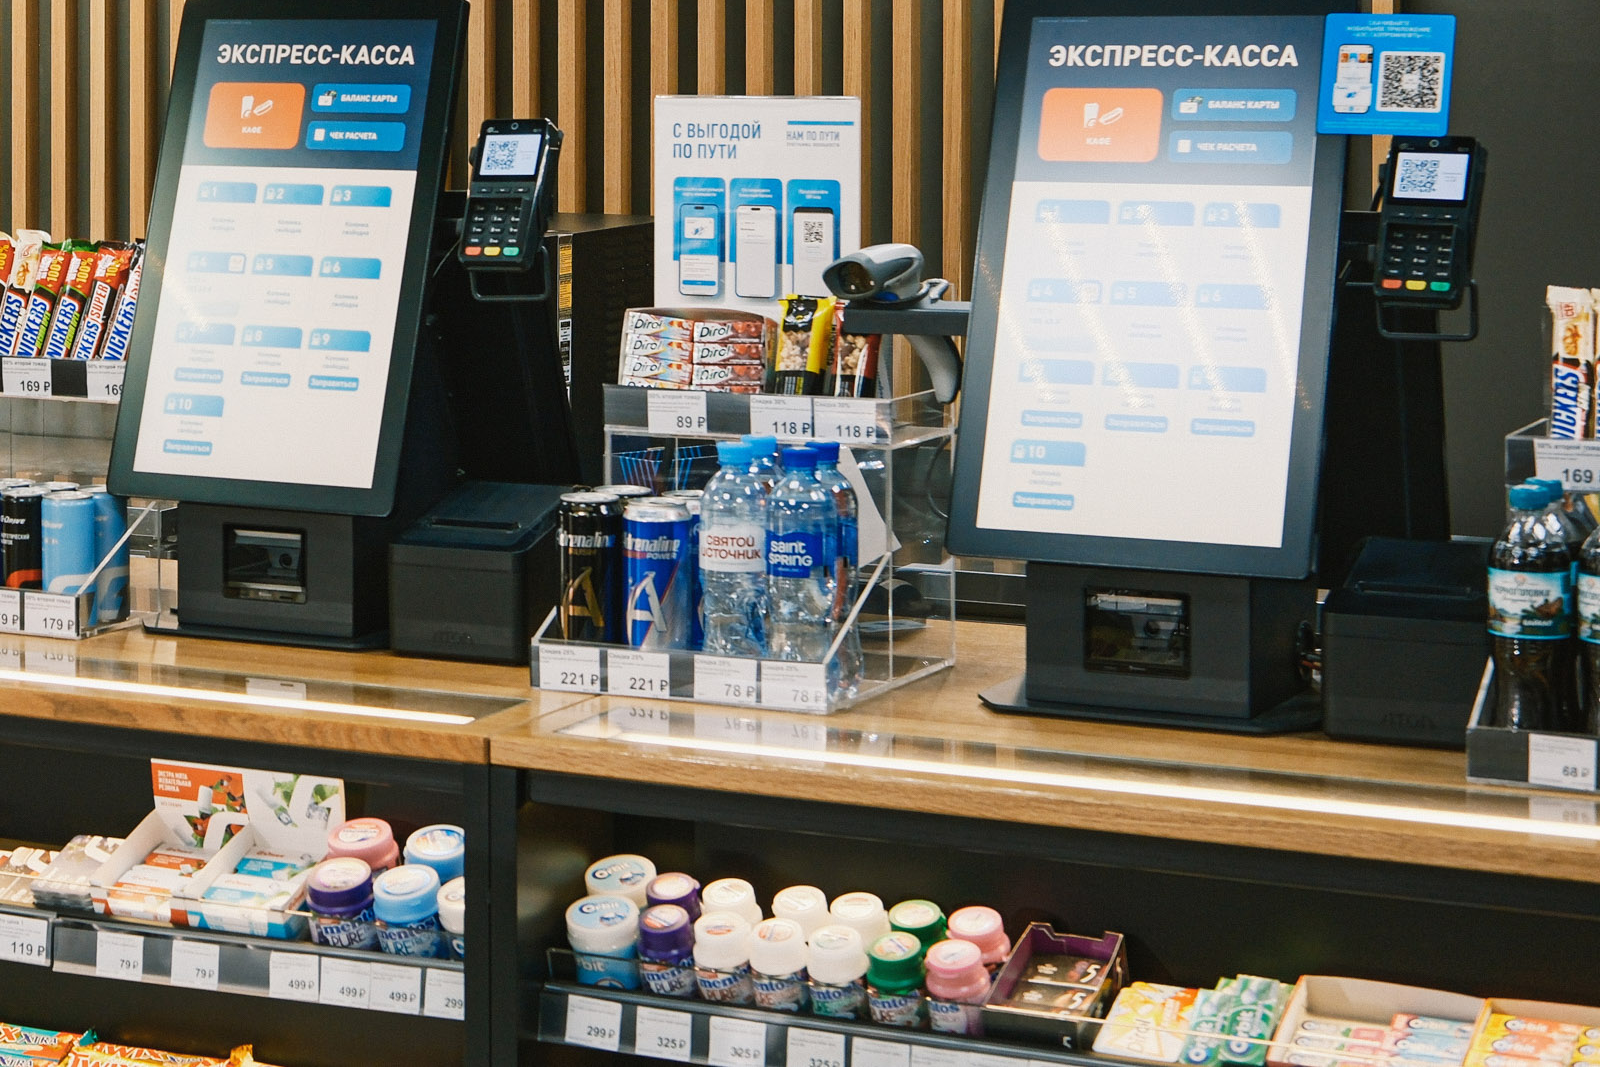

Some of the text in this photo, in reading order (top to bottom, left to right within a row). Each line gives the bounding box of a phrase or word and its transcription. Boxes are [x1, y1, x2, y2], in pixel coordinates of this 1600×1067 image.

[217, 44, 415, 65] ЭКСПРЕСС-КАССА
[1049, 45, 1298, 67] ЭКСПРЕСС-КАССА
[341, 94, 370, 102] БАЛАНС
[1208, 100, 1280, 109] БАЛАНС КАРТЫ
[345, 132, 377, 140] РАСЧЕТА
[673, 121, 761, 140] С ВЫГОДОЙ
[787, 131, 840, 141] НАМ ПО ПУТИ
[673, 144, 737, 159] ПО ПУТИ
[91, 283, 109, 320] SUPER
[635, 318, 664, 330] Dirol
[700, 326, 730, 339] Dirol
[676, 416, 692, 428] 89
[773, 422, 797, 434] 118
[1562, 469, 1593, 483] 169
[707, 535, 755, 547] СВЯТОЙ
[561, 671, 586, 685] 221
[288, 979, 306, 990] 499
[587, 1027, 605, 1039] 299
